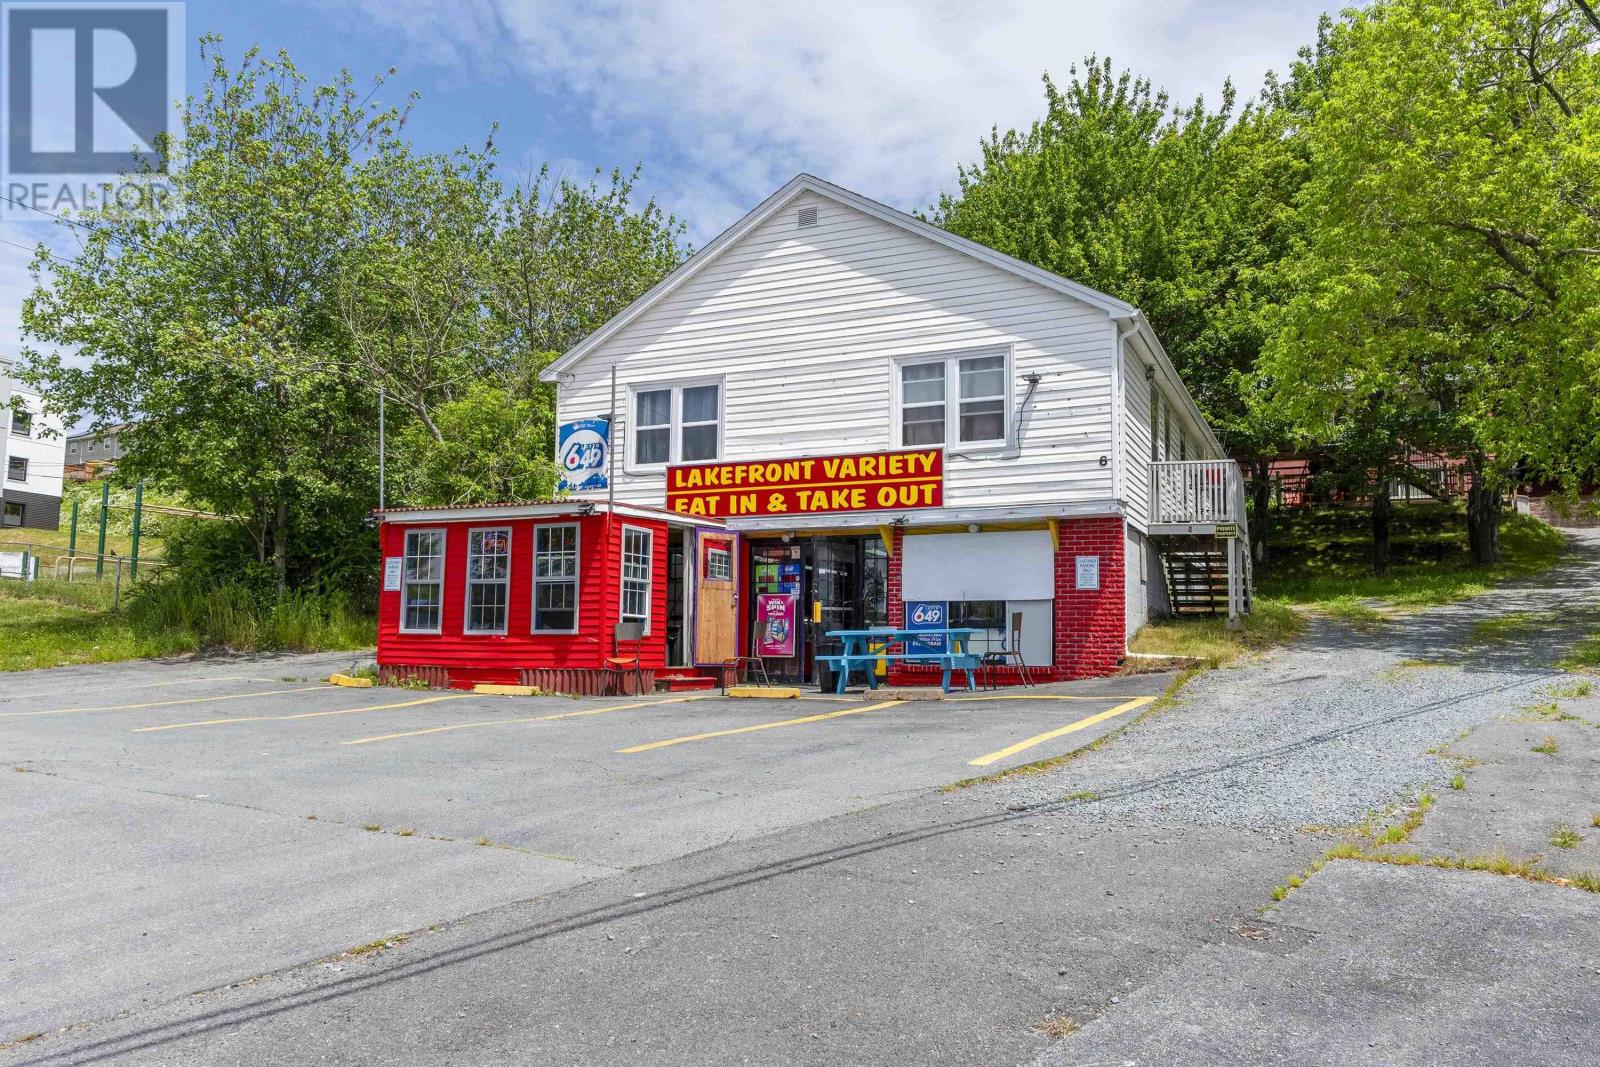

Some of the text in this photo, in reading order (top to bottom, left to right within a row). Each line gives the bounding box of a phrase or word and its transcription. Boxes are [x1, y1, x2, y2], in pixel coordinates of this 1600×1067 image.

[675, 451, 937, 488] LAKEFRONT VARIETY
[1099, 455, 1108, 467] 6
[675, 484, 937, 515] EAT IN & TAKE OUT
